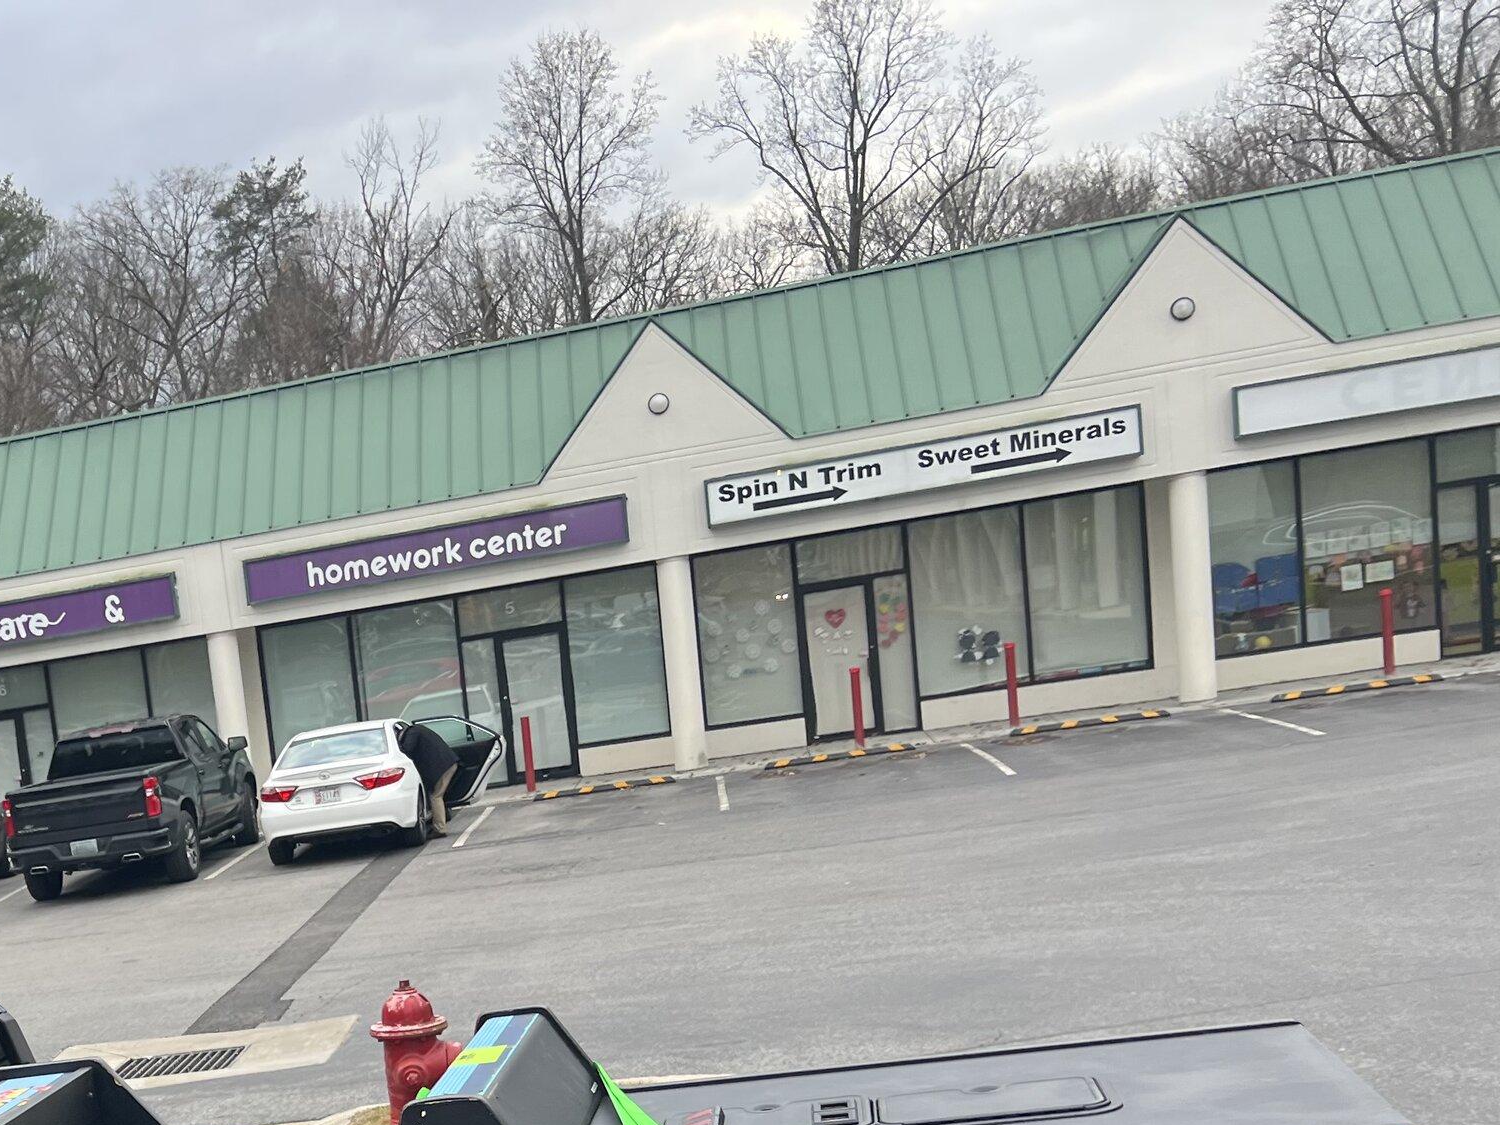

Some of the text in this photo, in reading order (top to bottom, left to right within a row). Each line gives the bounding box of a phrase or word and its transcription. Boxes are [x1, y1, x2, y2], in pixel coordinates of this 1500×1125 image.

[918, 417, 1126, 468] Sweet Minerals
[718, 462, 882, 504] Spin N Trim
[307, 523, 567, 588] homework center
[104, 594, 125, 623] &
